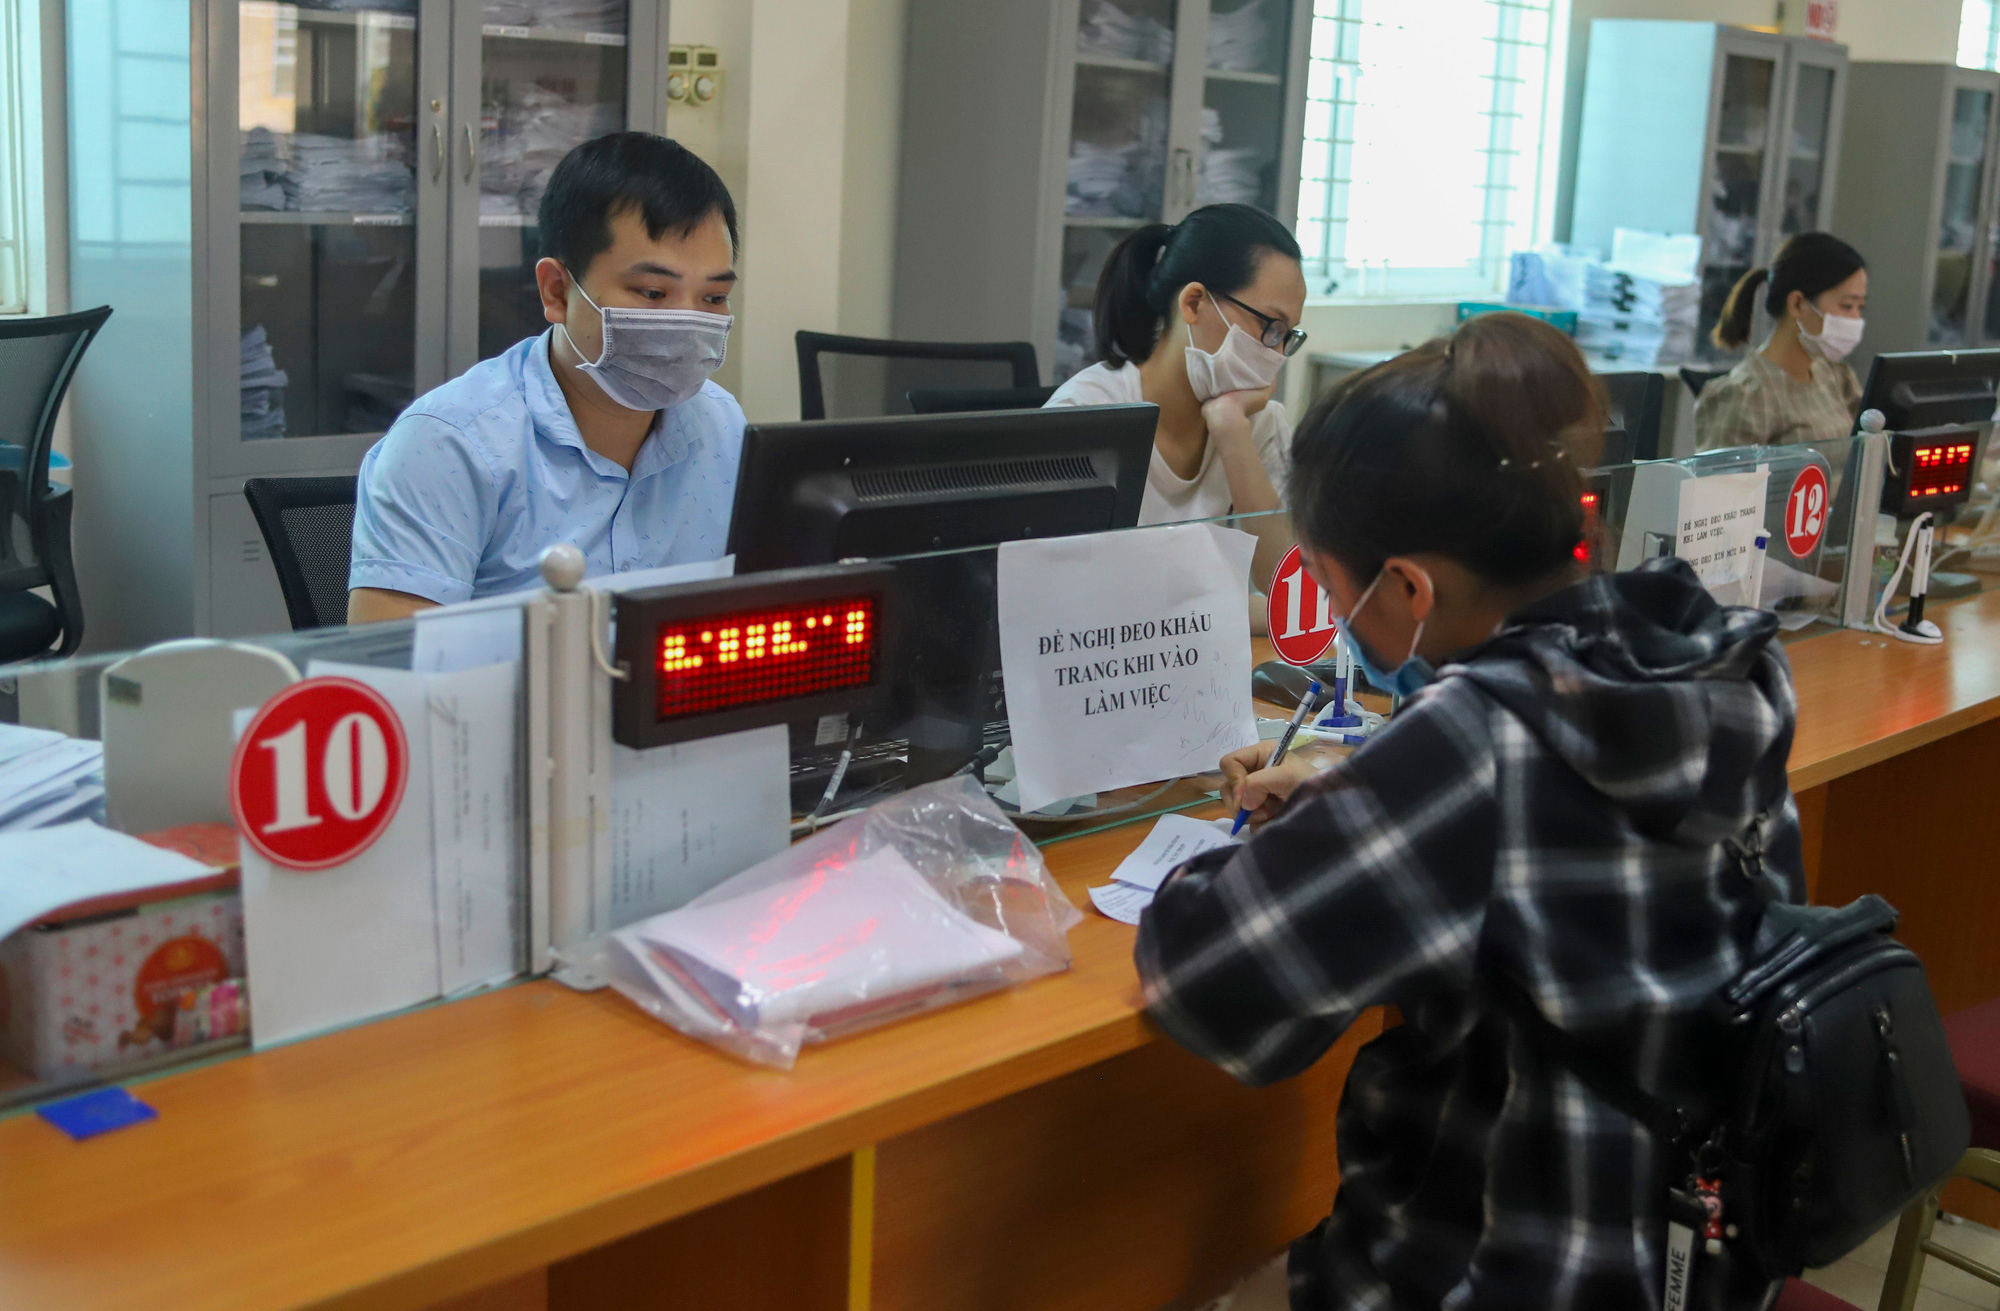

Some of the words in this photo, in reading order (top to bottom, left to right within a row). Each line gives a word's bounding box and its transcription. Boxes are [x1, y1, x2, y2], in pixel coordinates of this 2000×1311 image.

[1740, 506, 1756, 517] TRANG
[1790, 483, 1823, 538] 12
[1682, 534, 1694, 544] KHI
[1697, 529, 1708, 540] LÀM
[1714, 551, 1725, 560] XIN
[1280, 565, 1334, 640] 11
[1038, 628, 1064, 656] ĐỀ
[1069, 626, 1116, 651] NGHỊ
[1120, 621, 1156, 644] ĐEO
[1055, 659, 1119, 687] TRANG
[1124, 653, 1155, 676] KHI
[1159, 644, 1199, 669] VÀO
[1084, 689, 1126, 716] LÀM
[1129, 682, 1171, 709] VIỆC
[258, 711, 389, 835] 10
